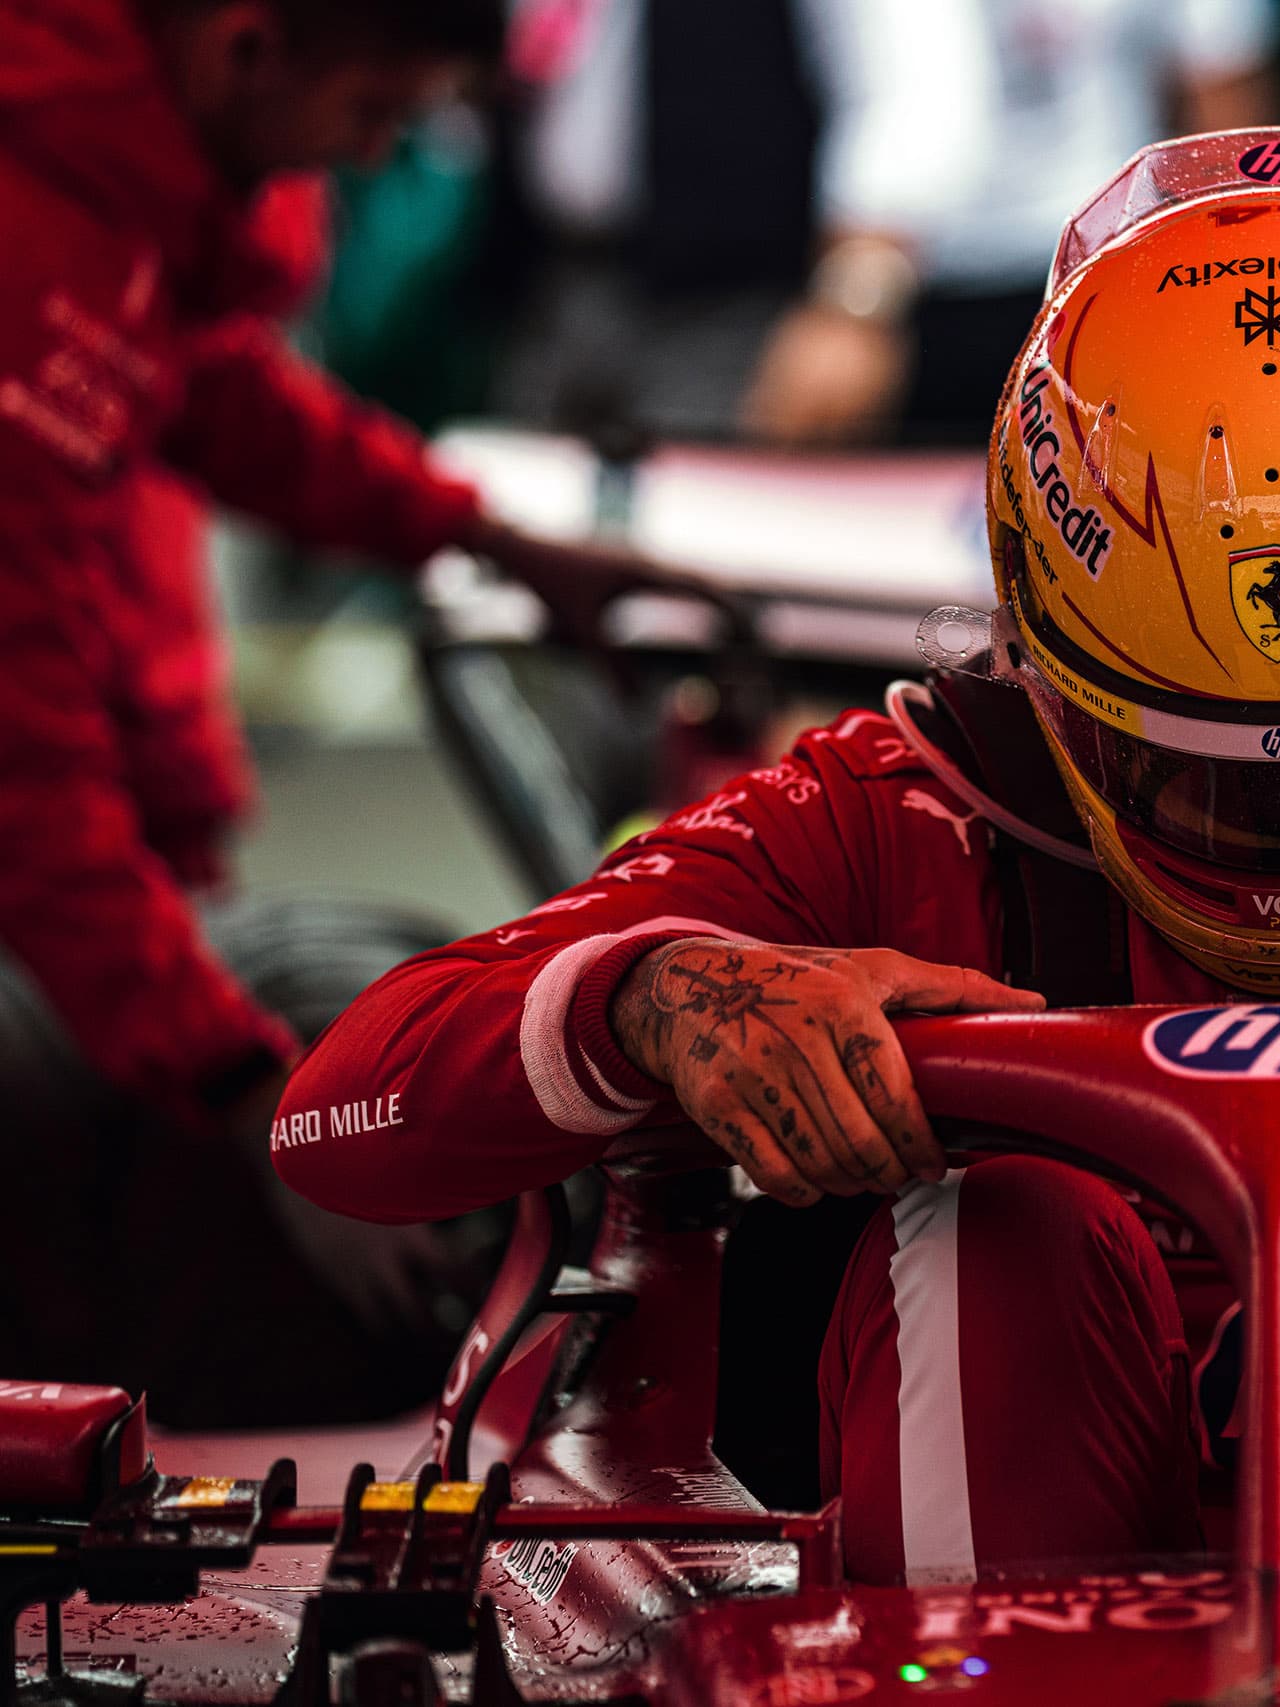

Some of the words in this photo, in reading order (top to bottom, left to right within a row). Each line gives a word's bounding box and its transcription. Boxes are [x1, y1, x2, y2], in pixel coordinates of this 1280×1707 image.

[1020, 361, 1112, 575] UniCredit
[1033, 645, 1078, 694] RICHARD
[1082, 689, 1126, 720] MILLE
[329, 1092, 404, 1138] MILLE
